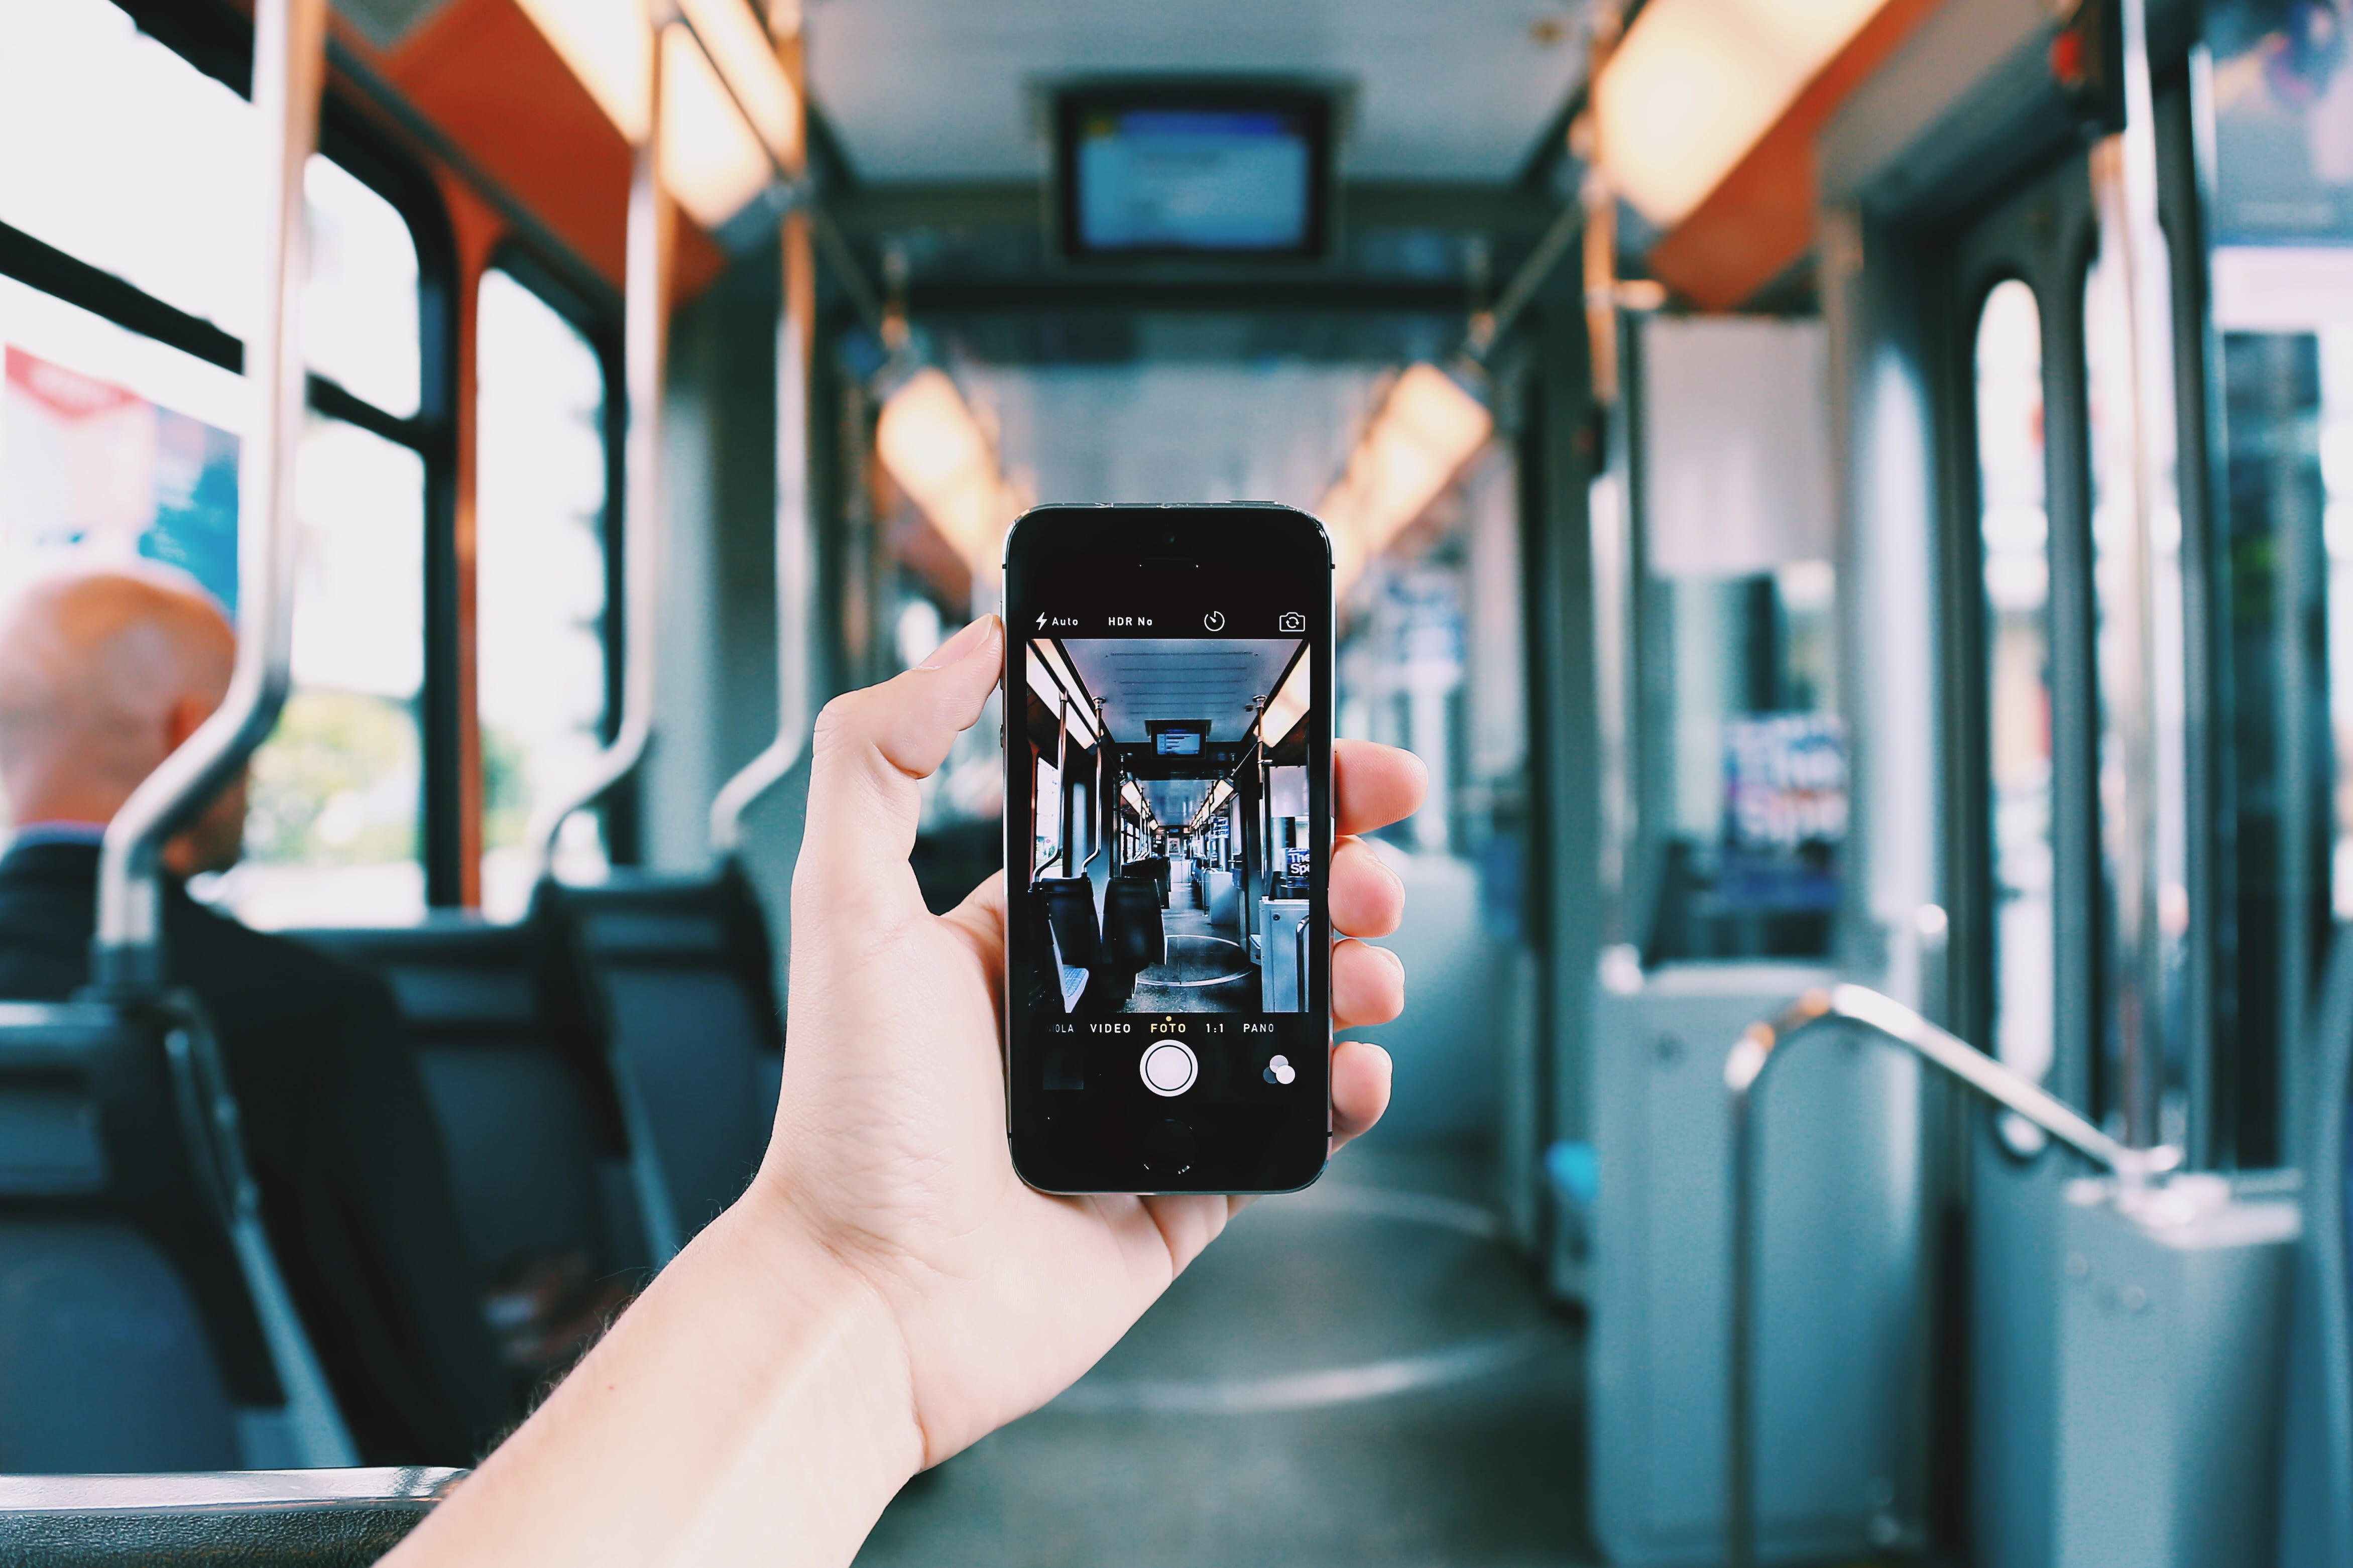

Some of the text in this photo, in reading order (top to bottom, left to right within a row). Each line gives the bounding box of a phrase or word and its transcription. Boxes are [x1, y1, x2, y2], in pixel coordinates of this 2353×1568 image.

[1051, 617, 1078, 626] Auto
[1108, 617, 1152, 626] HDR No
[1090, 1023, 1130, 1033] VIDEO
[1150, 1023, 1186, 1033] FOTO
[1206, 1023, 1224, 1033] 1:1
[1243, 1023, 1274, 1033] PANO
